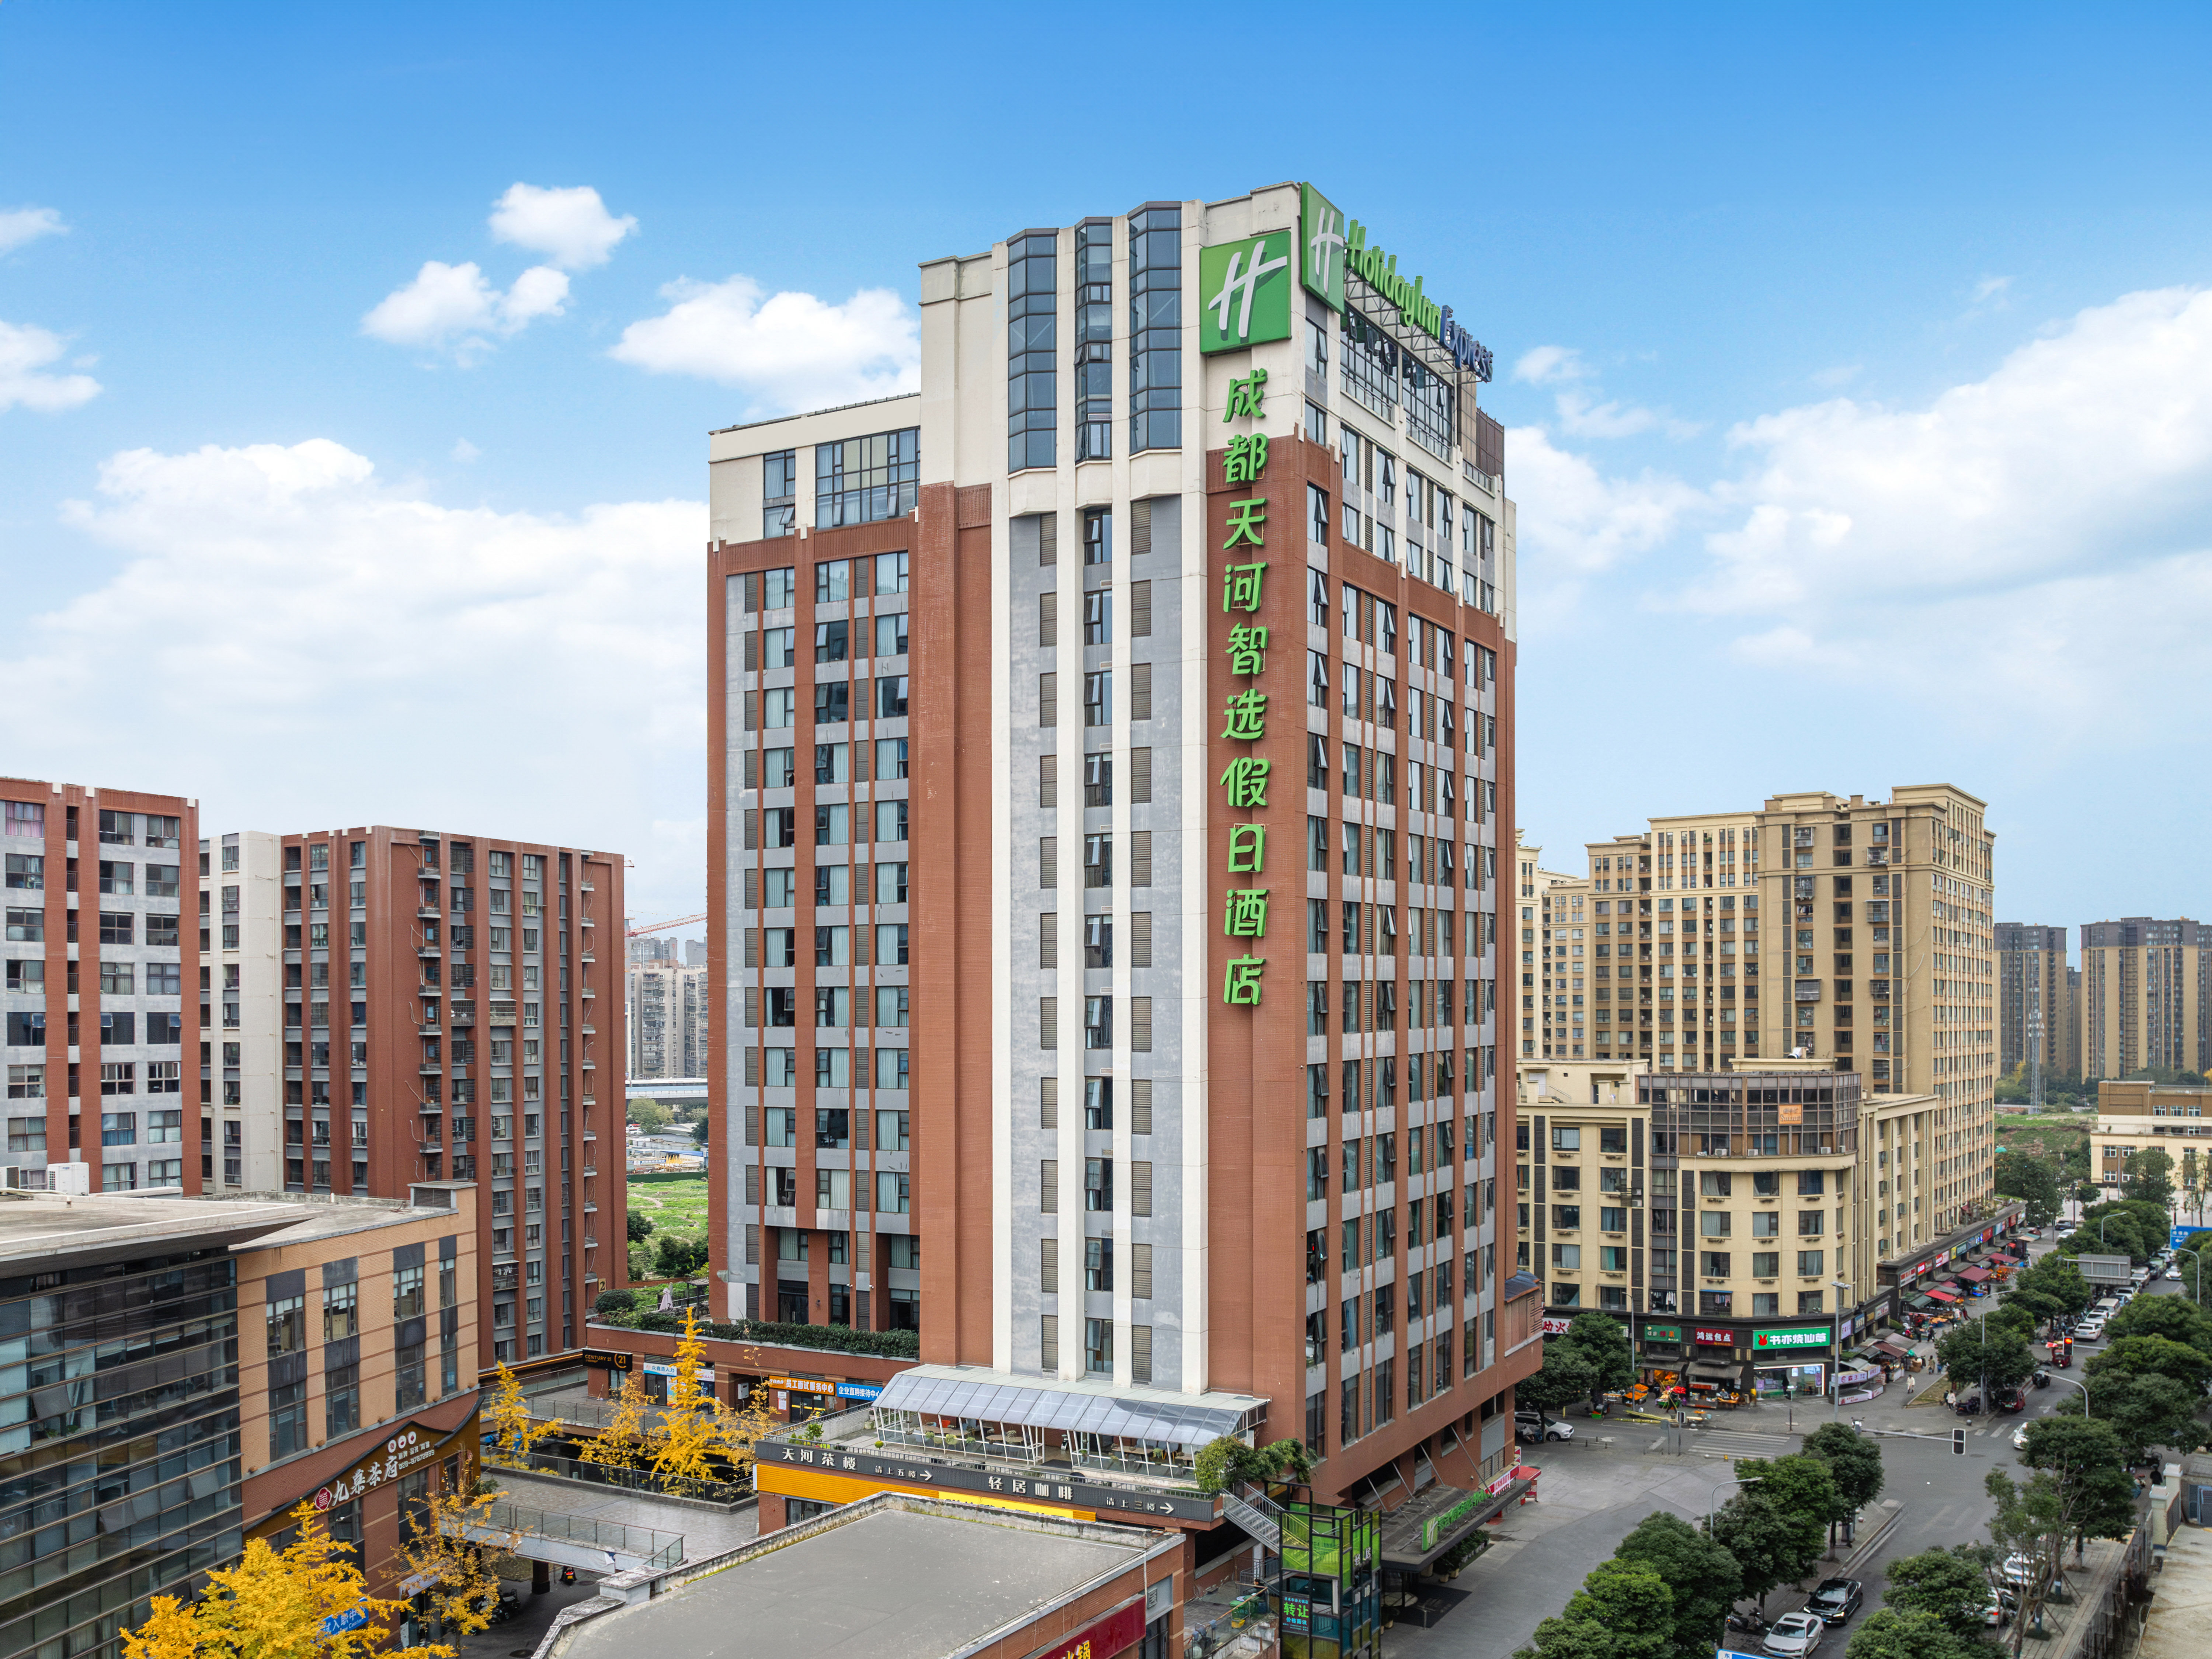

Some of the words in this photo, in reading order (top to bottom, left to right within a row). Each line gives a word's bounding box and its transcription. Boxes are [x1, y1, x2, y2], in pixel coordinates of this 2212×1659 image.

[1345, 219, 1415, 327] Holiday
[1414, 275, 1441, 340] Inn
[1440, 305, 1493, 382] Express
[1220, 368, 1271, 1005] 成都天河智选假日酒店
[600, 1281, 605, 1291] 2
[1697, 1331, 1731, 1342] 鸿运包点
[1770, 1333, 1826, 1345] 书亦烧仙草
[786, 1379, 834, 1393] 员工面试服务中心
[782, 1447, 857, 1470] 天河茶楼
[875, 1465, 917, 1478] 请上五楼
[988, 1476, 1073, 1500] 轻居咖啡
[1106, 1496, 1156, 1512] 请上三楼
[1284, 1602, 1309, 1618] 转让
